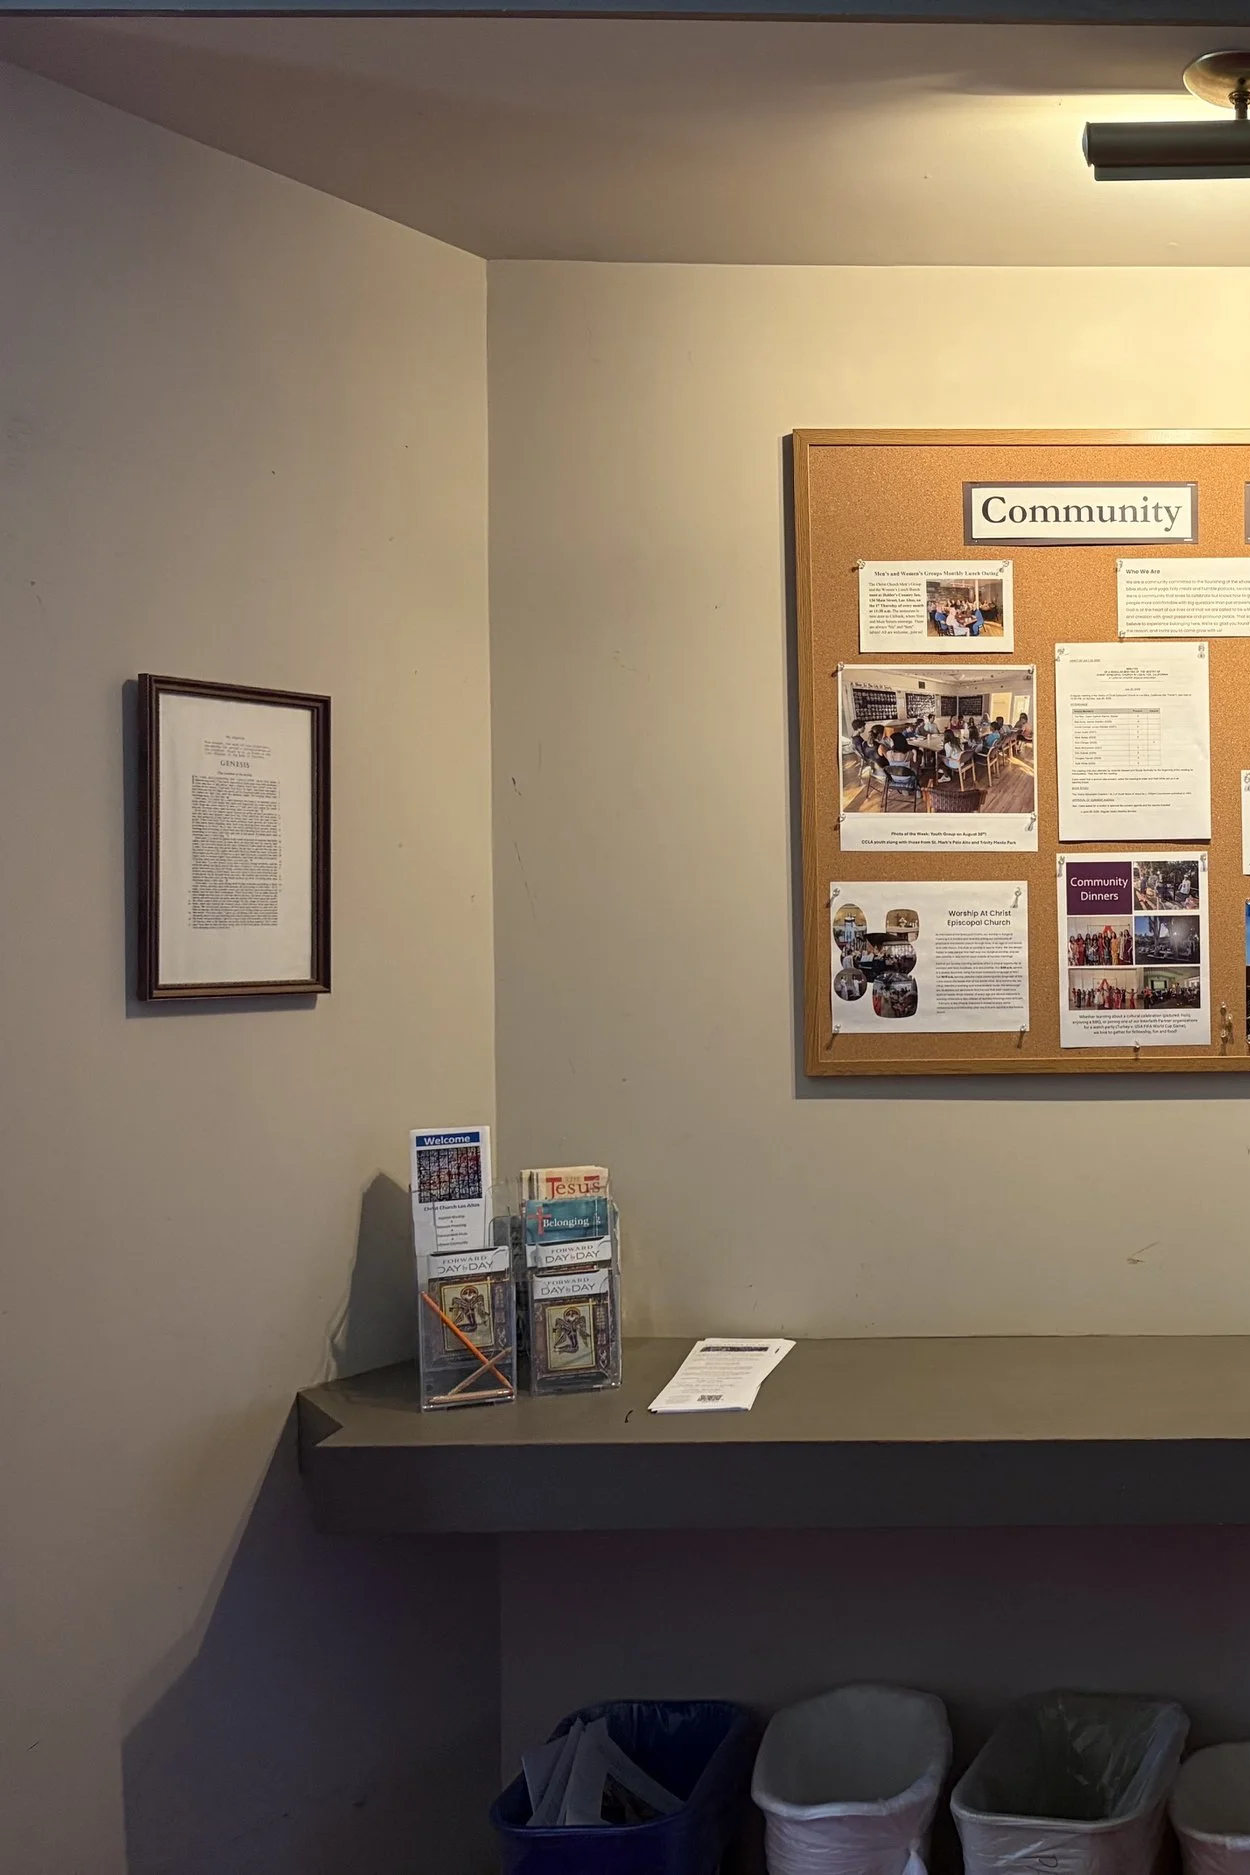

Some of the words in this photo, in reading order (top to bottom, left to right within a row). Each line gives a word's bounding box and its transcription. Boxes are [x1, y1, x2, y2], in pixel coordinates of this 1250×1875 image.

[982, 496, 1182, 532] Community
[220, 760, 250, 768] GENESIS
[1070, 876, 1128, 888] Community
[1080, 891, 1119, 901] Dinners
[424, 1135, 470, 1146] Welcome
[546, 1176, 600, 1199] Jesus
[543, 1217, 590, 1228] Belonging
[551, 1245, 594, 1254] FORWARD
[443, 1256, 487, 1264] FORWARD
[545, 1254, 570, 1264] DAY
[576, 1250, 600, 1260] DAY
[468, 1261, 494, 1271] DAY
[541, 1287, 566, 1296] DAY
[571, 1283, 596, 1292] DAY
